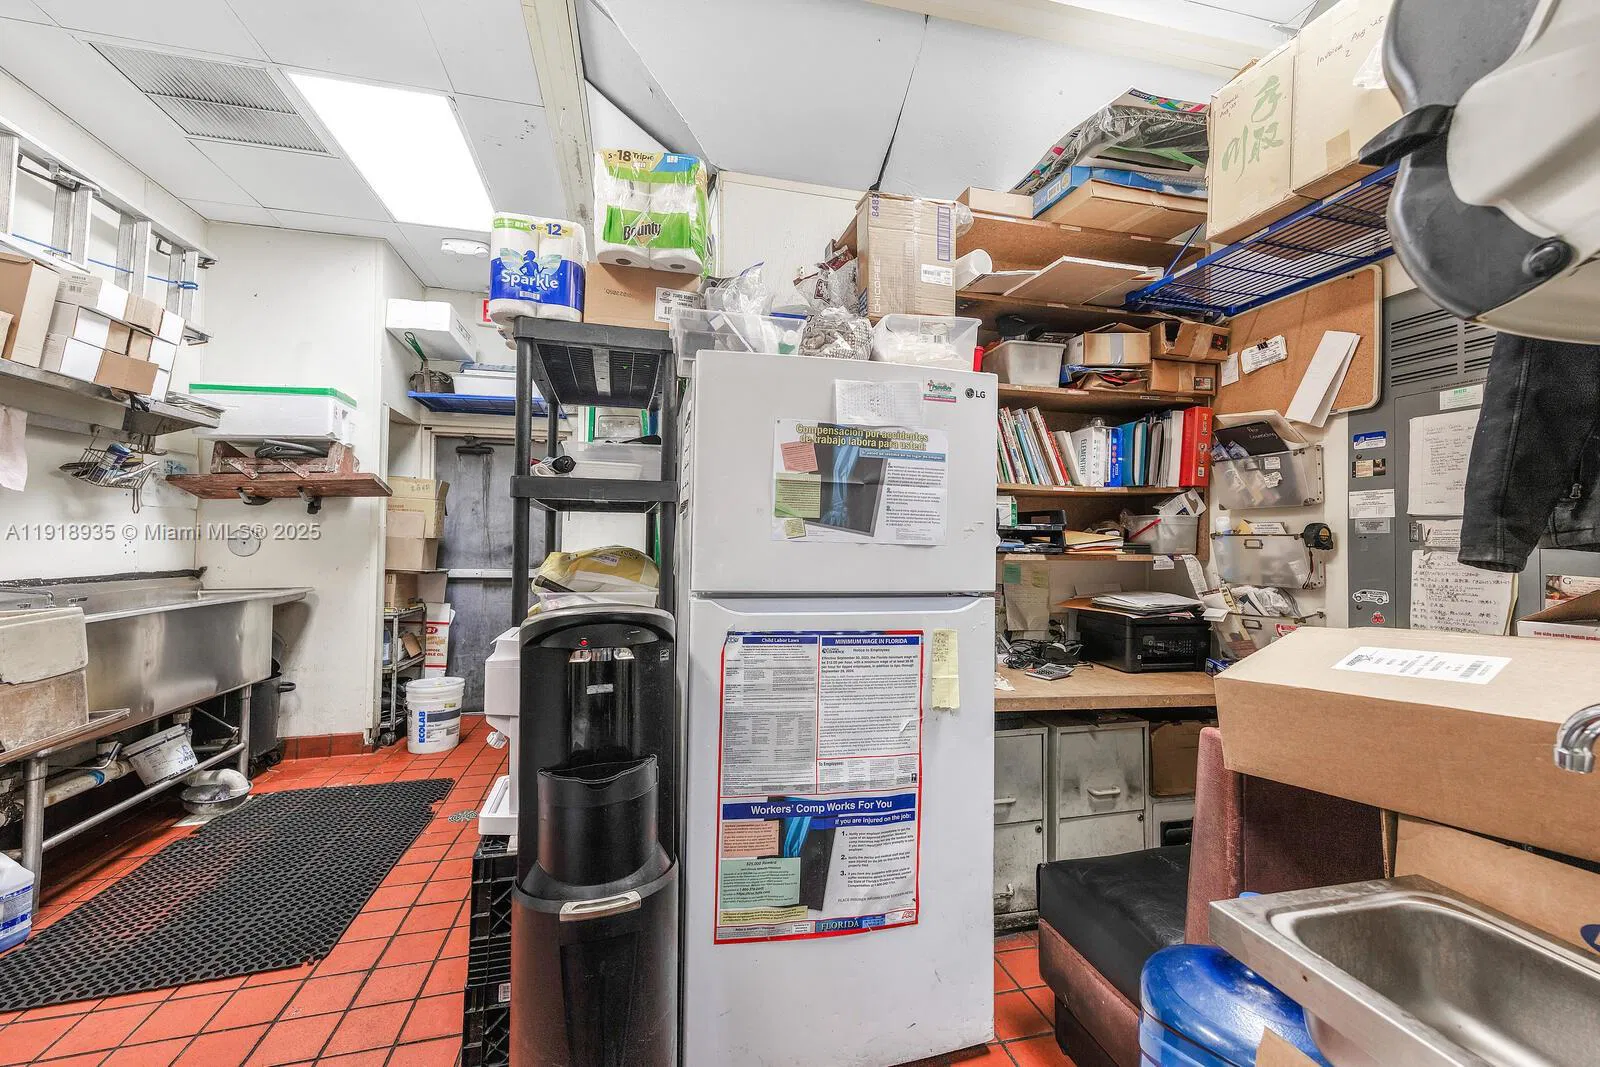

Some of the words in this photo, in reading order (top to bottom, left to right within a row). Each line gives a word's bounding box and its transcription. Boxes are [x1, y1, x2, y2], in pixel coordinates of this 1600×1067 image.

[617, 150, 632, 161] 18
[546, 223, 561, 236] 12
[624, 222, 661, 240] Bounty
[501, 270, 559, 291] Sparkle
[800, 434, 810, 443] de
[814, 435, 846, 447] trabajo
[848, 437, 876, 447] labora
[878, 439, 901, 449] para
[866, 431, 879, 439] por
[881, 431, 928, 442] accidentes
[751, 806, 793, 815] Workers'
[796, 804, 825, 814] Comp
[827, 802, 855, 811] Works
[858, 801, 874, 809] For
[875, 800, 892, 809] You
[822, 921, 859, 932] FLORIDA
